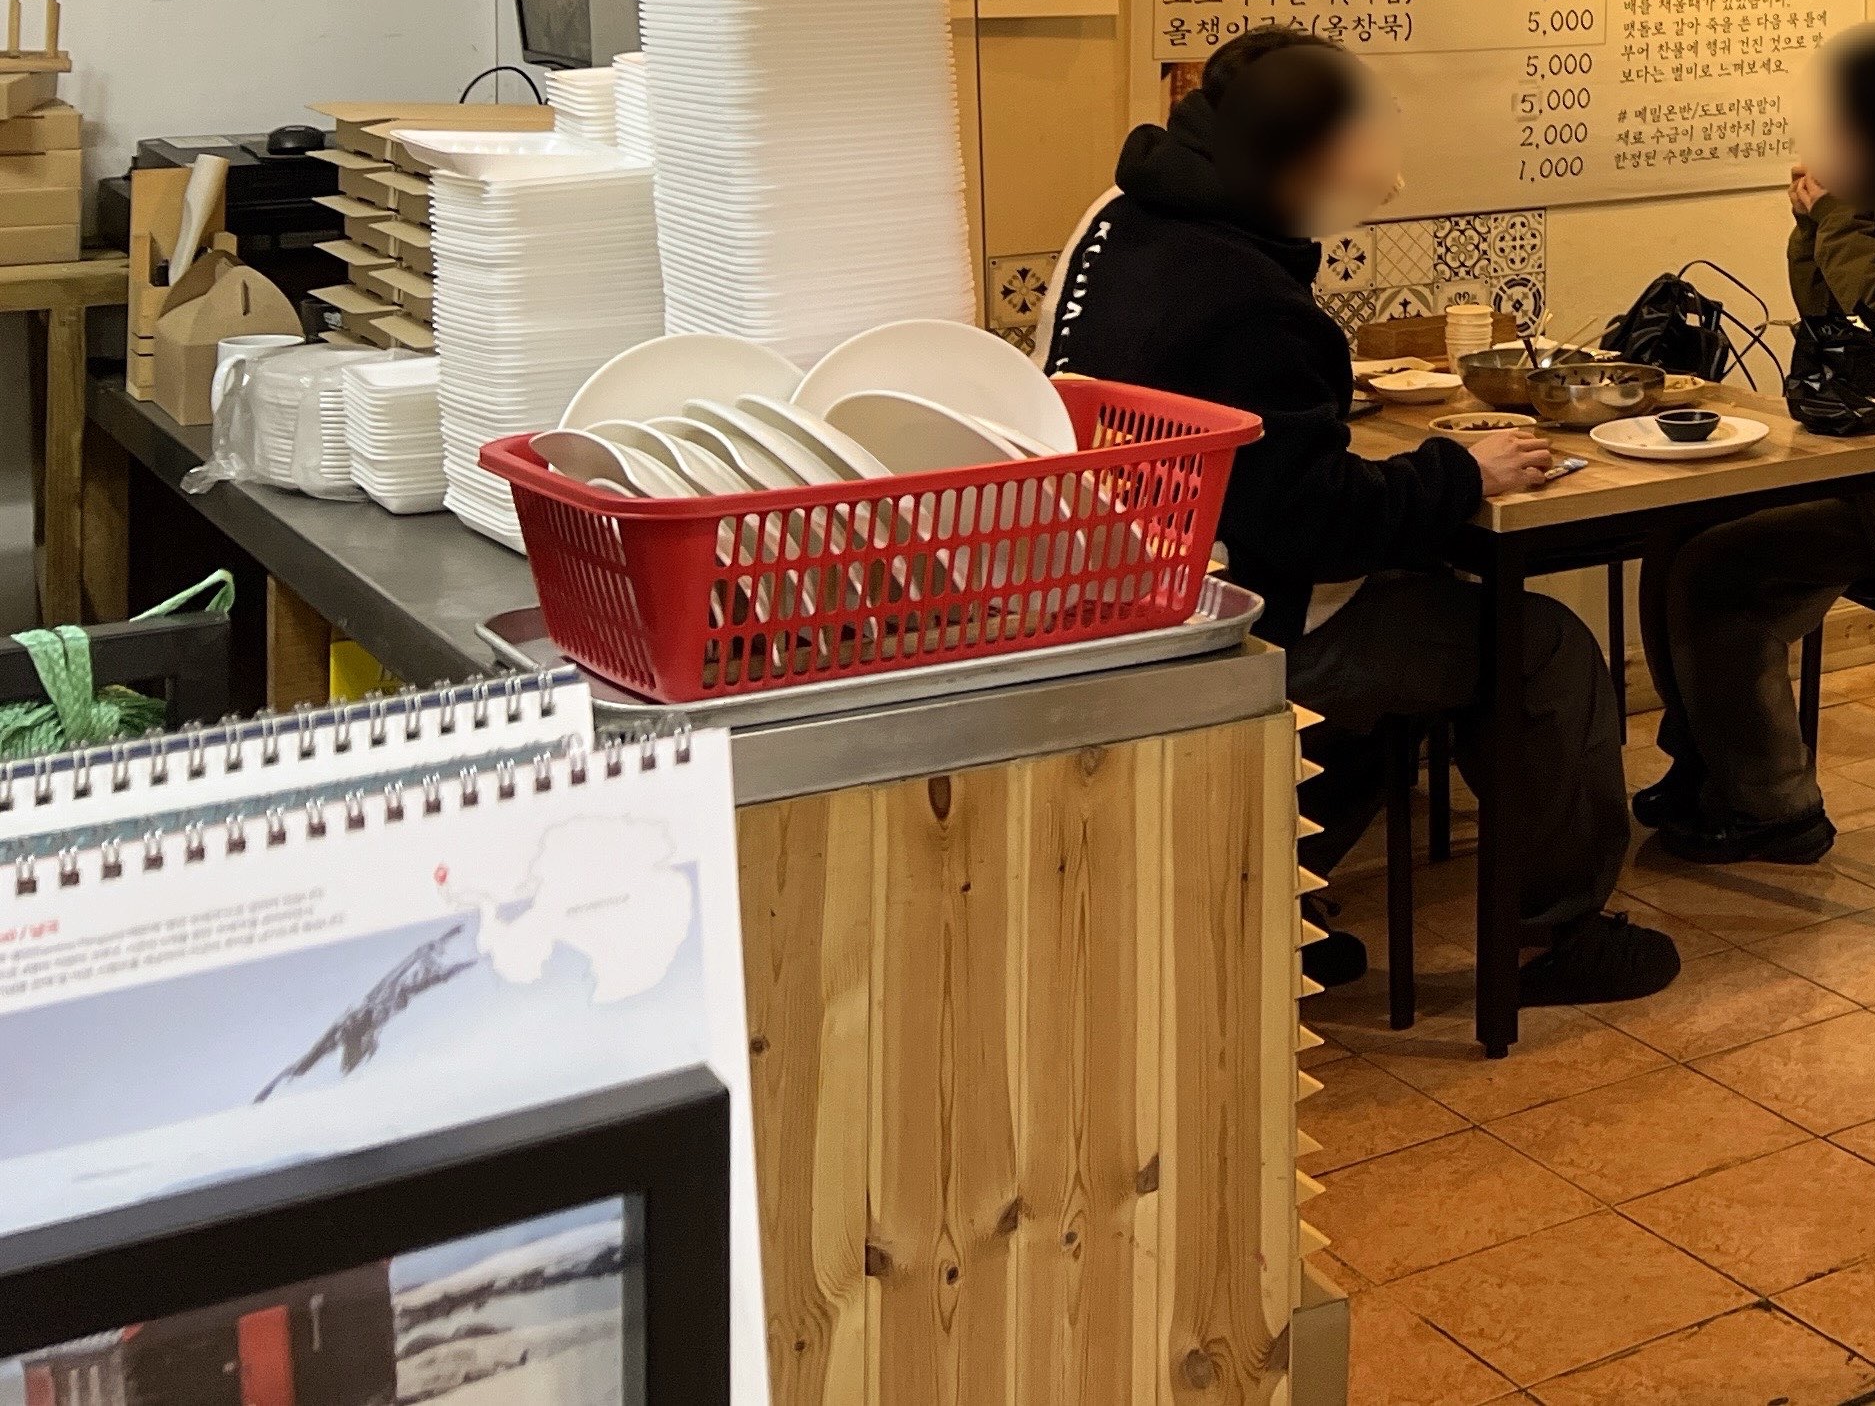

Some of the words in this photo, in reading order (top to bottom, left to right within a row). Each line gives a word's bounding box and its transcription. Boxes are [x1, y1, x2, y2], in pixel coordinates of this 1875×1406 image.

[1527, 9, 1594, 36] 5,000
[1526, 53, 1592, 80] 5,000
[1521, 87, 1591, 115] 5,000
[1520, 122, 1587, 149] 2,000
[1519, 156, 1583, 182] 1,000
